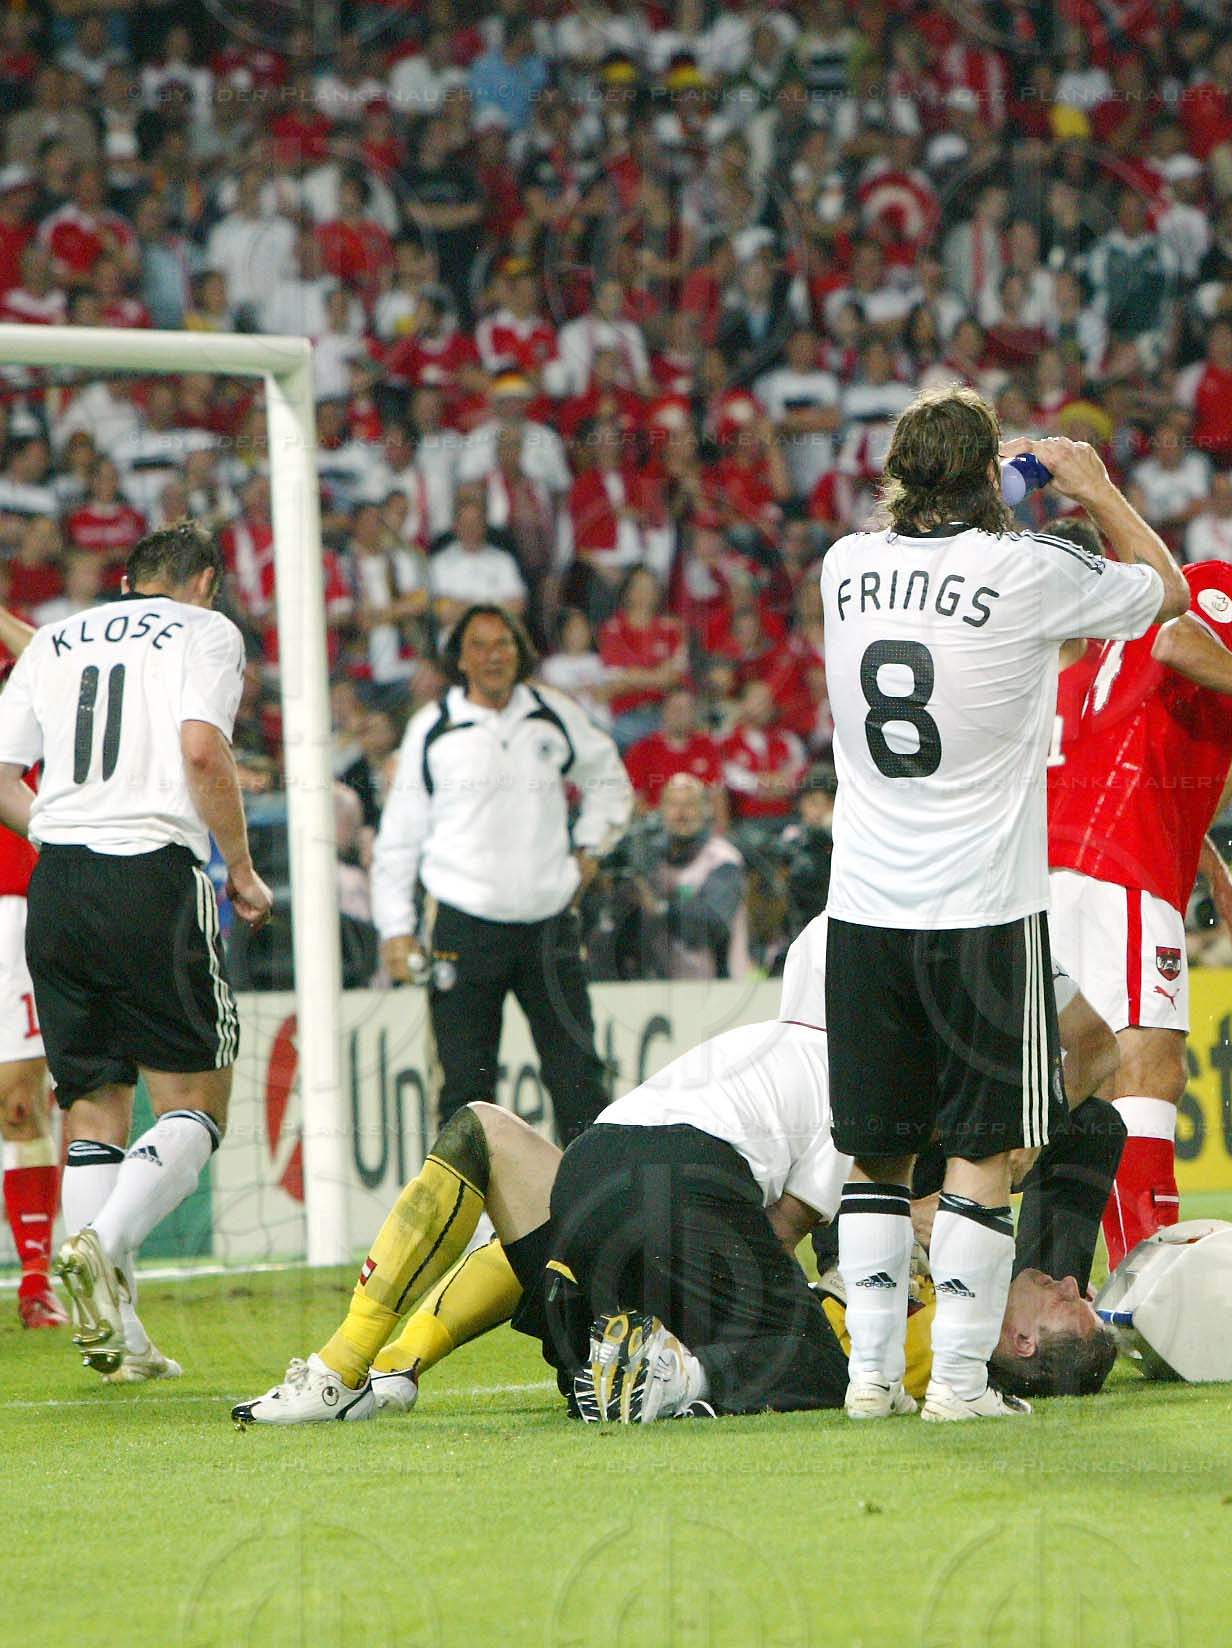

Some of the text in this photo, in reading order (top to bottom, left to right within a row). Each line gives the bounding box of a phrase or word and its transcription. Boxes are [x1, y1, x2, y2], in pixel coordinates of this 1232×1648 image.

[52, 612, 184, 657] KLOSE
[837, 569, 1000, 628] FRINGS
[73, 662, 126, 785] 11
[860, 639, 943, 778] 8
